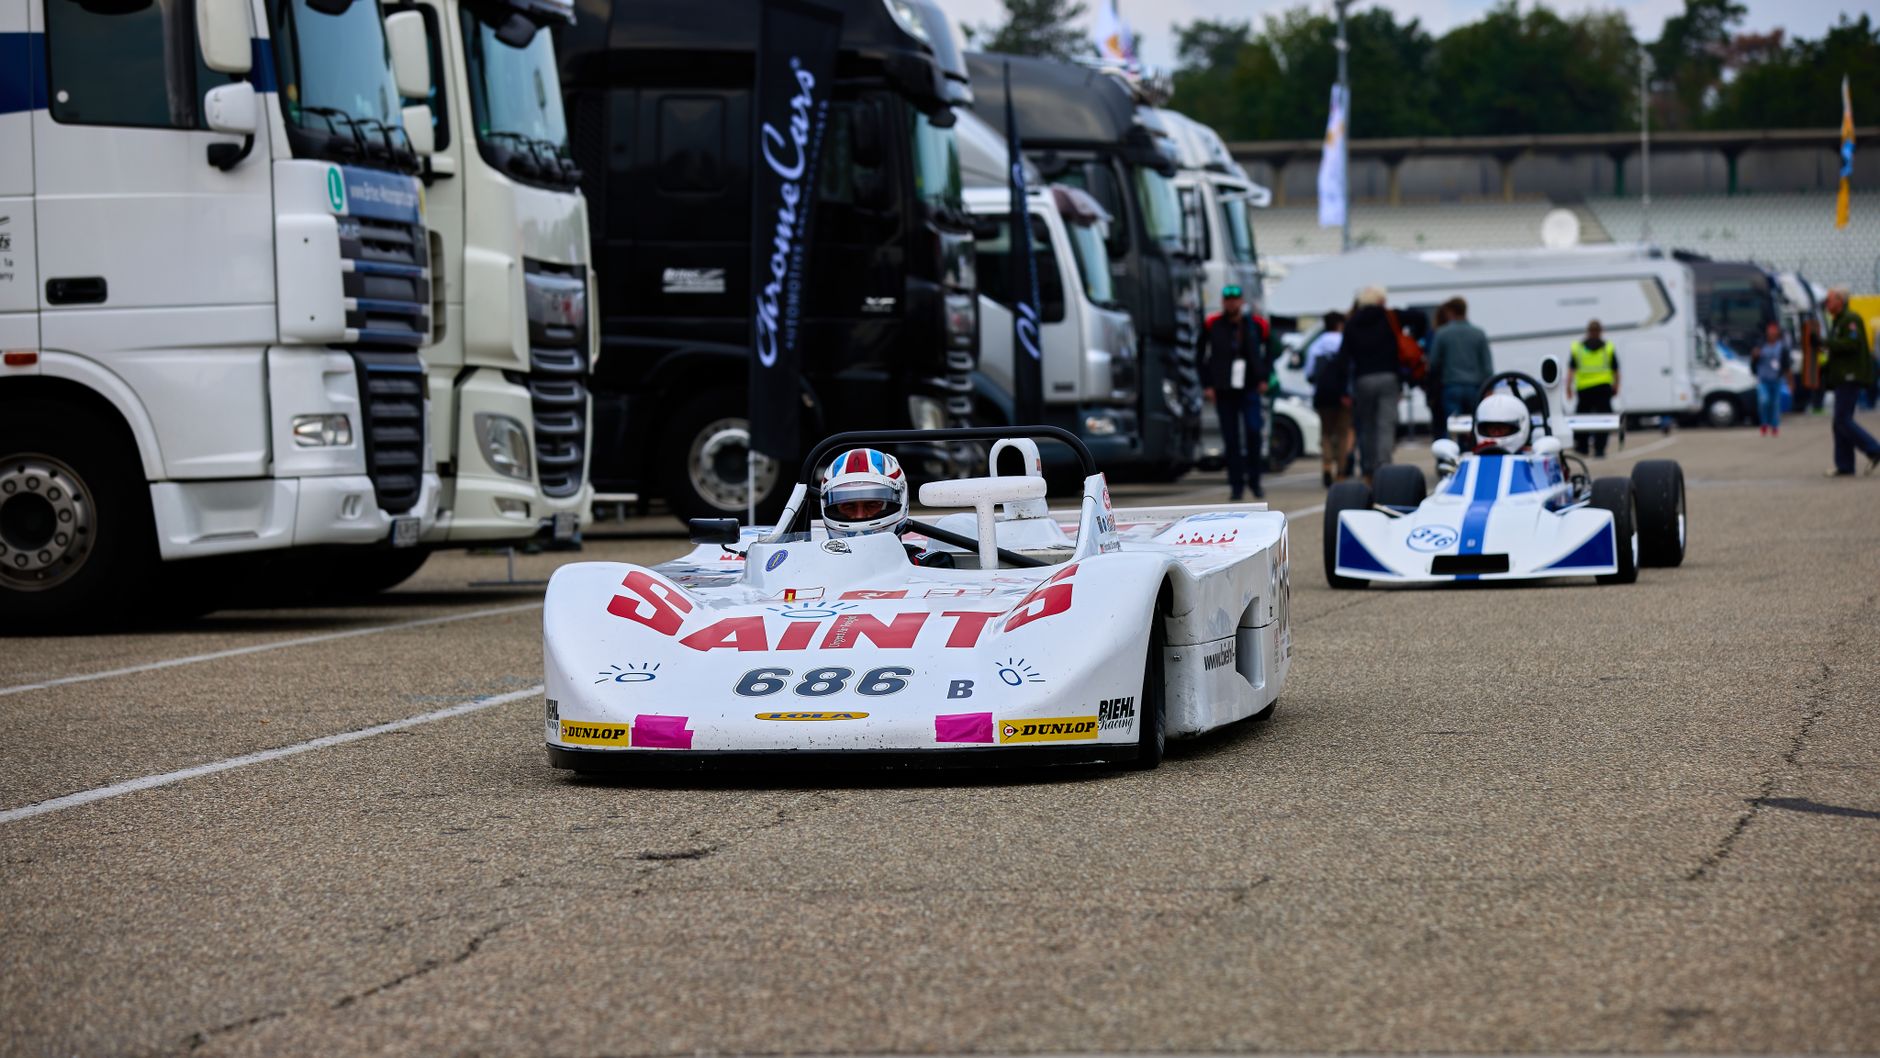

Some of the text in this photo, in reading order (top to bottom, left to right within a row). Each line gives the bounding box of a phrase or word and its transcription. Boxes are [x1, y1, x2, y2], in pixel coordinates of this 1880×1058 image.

[607, 563, 1080, 652] SAINTS
[733, 666, 915, 697] 686
[947, 679, 975, 699] B
[1099, 696, 1135, 721] BIEHL
[567, 726, 626, 740] DUNLOP
[1020, 721, 1096, 736] DUNLOP
